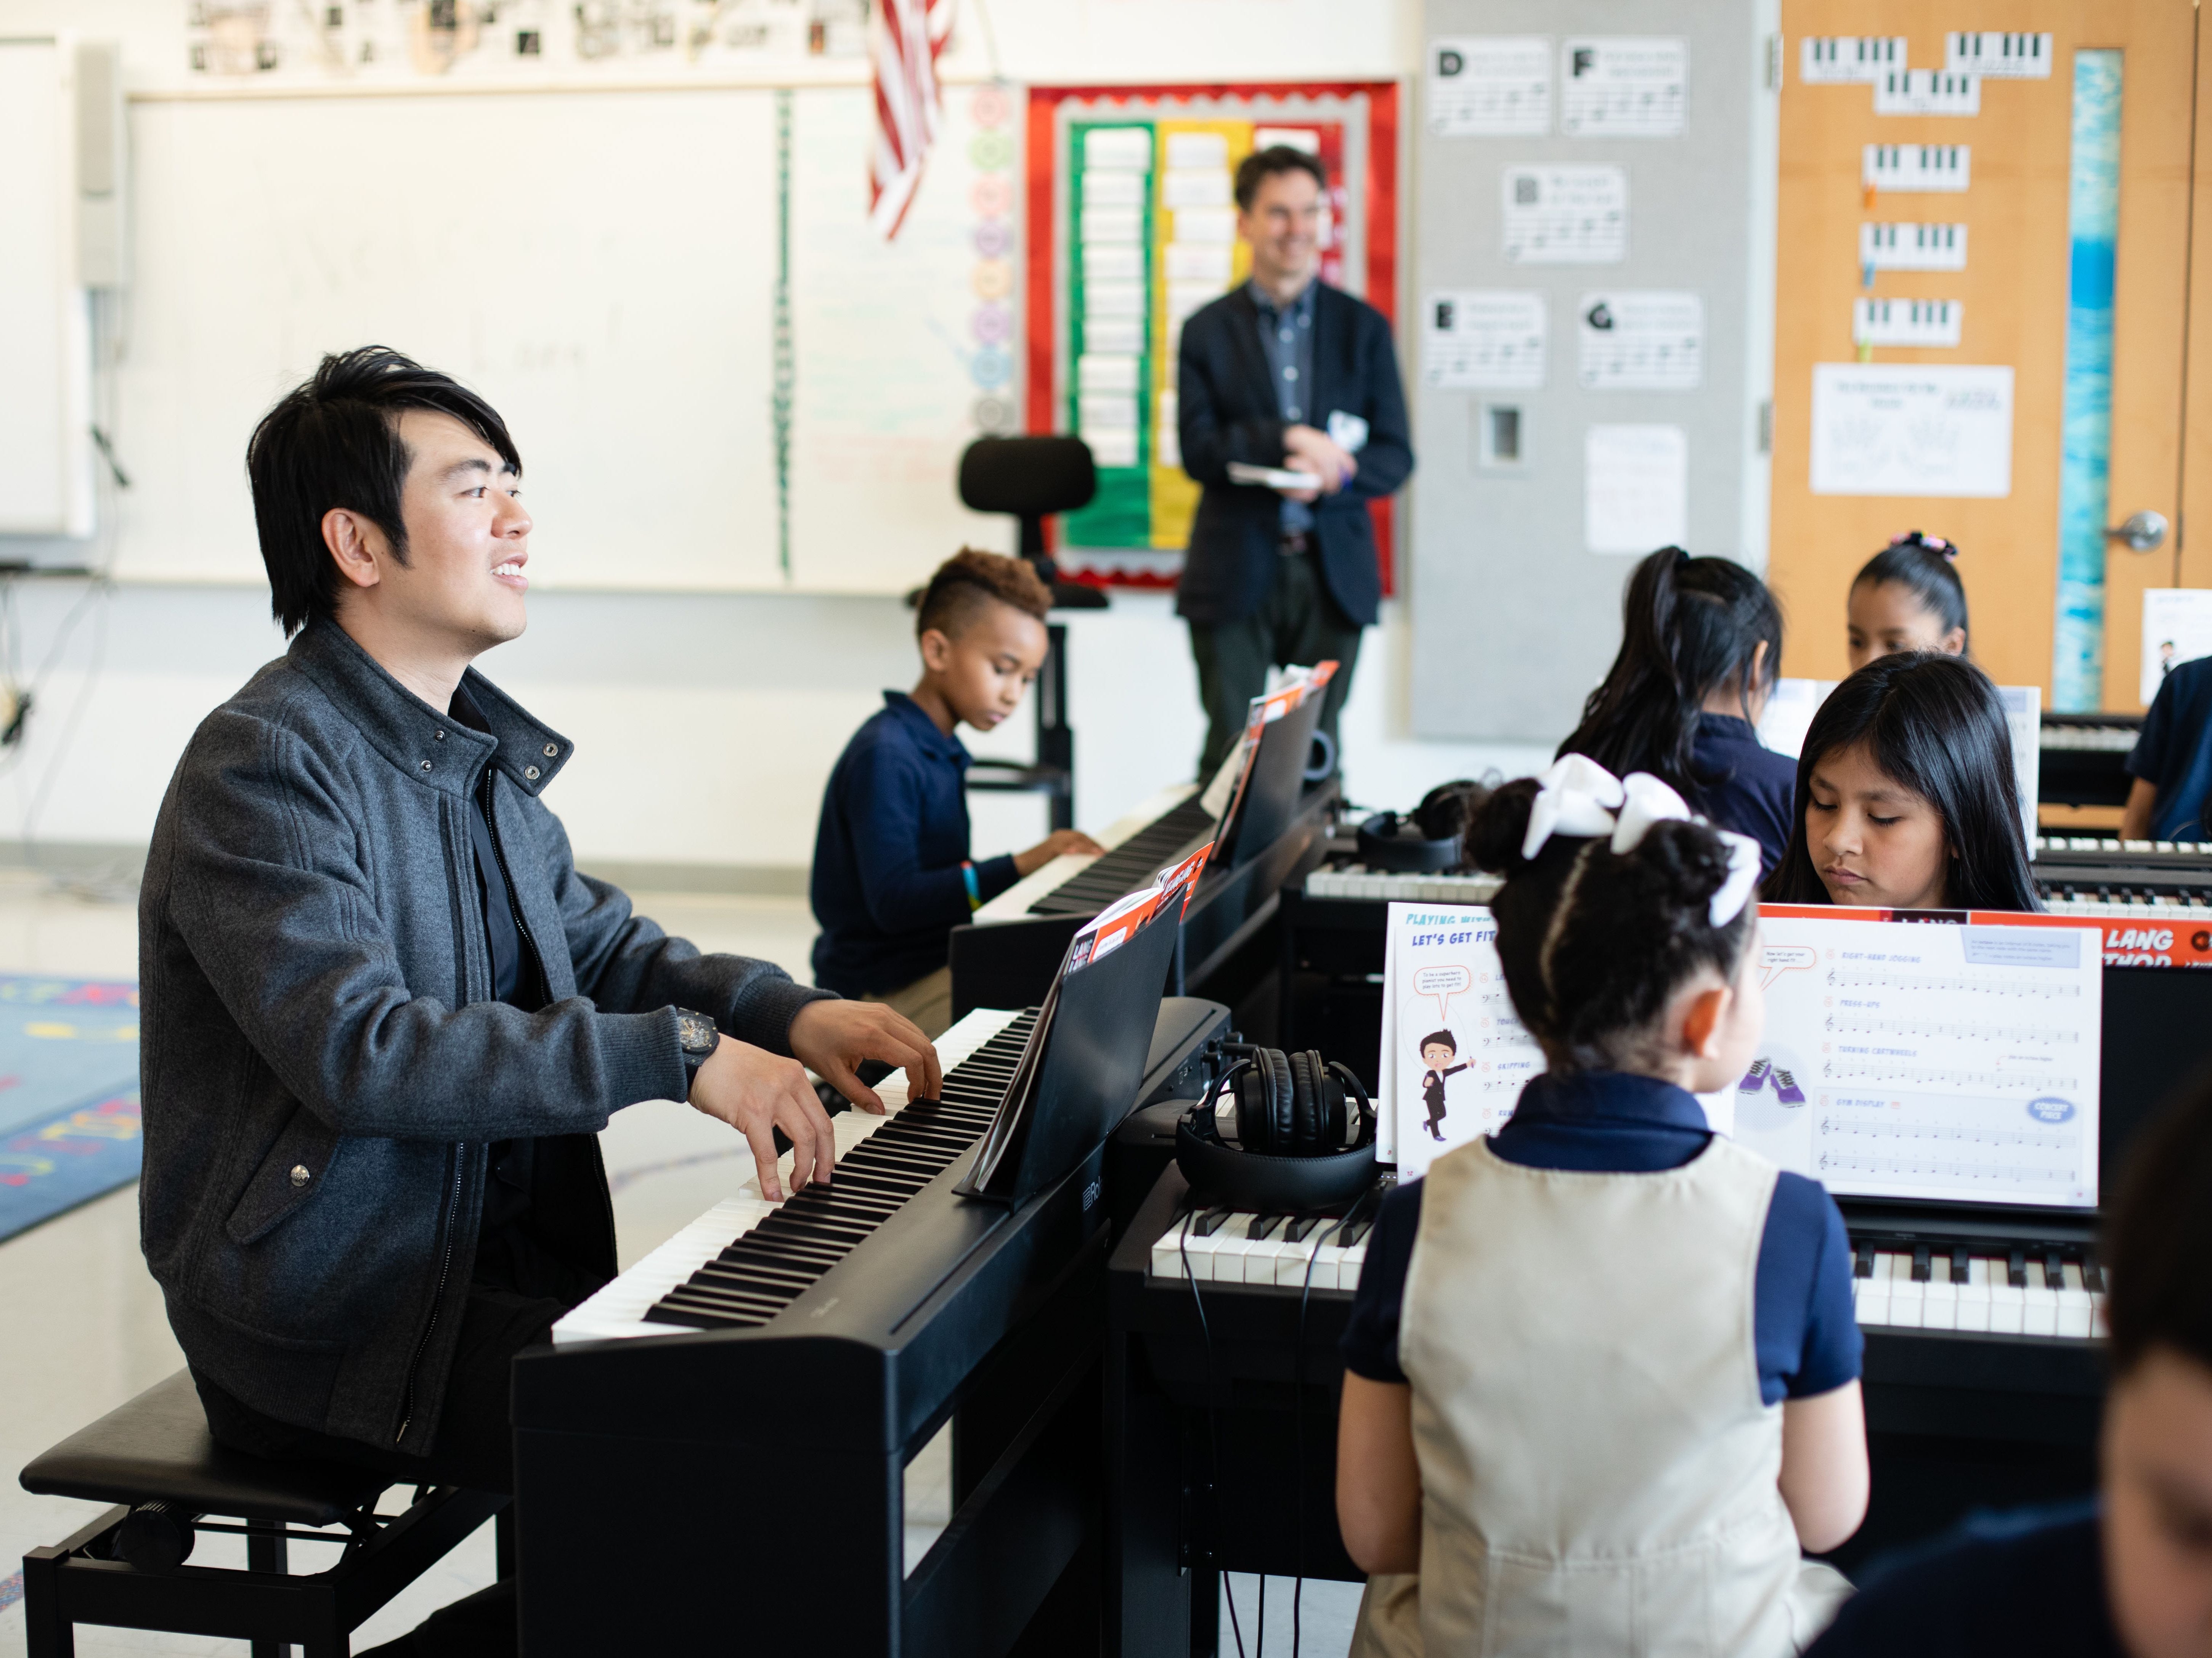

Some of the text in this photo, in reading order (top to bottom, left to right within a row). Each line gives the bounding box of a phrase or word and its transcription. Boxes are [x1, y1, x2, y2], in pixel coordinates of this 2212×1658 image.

[1439, 51, 1463, 77] D
[1573, 49, 1596, 77] F
[1587, 301, 1615, 331] G
[1406, 914, 1455, 925] PLAYING
[1412, 934, 1445, 946] LET'S
[1450, 932, 1472, 944] GET
[2106, 929, 2174, 951] LANG
[1498, 1061, 1531, 1070] SKIPPING
